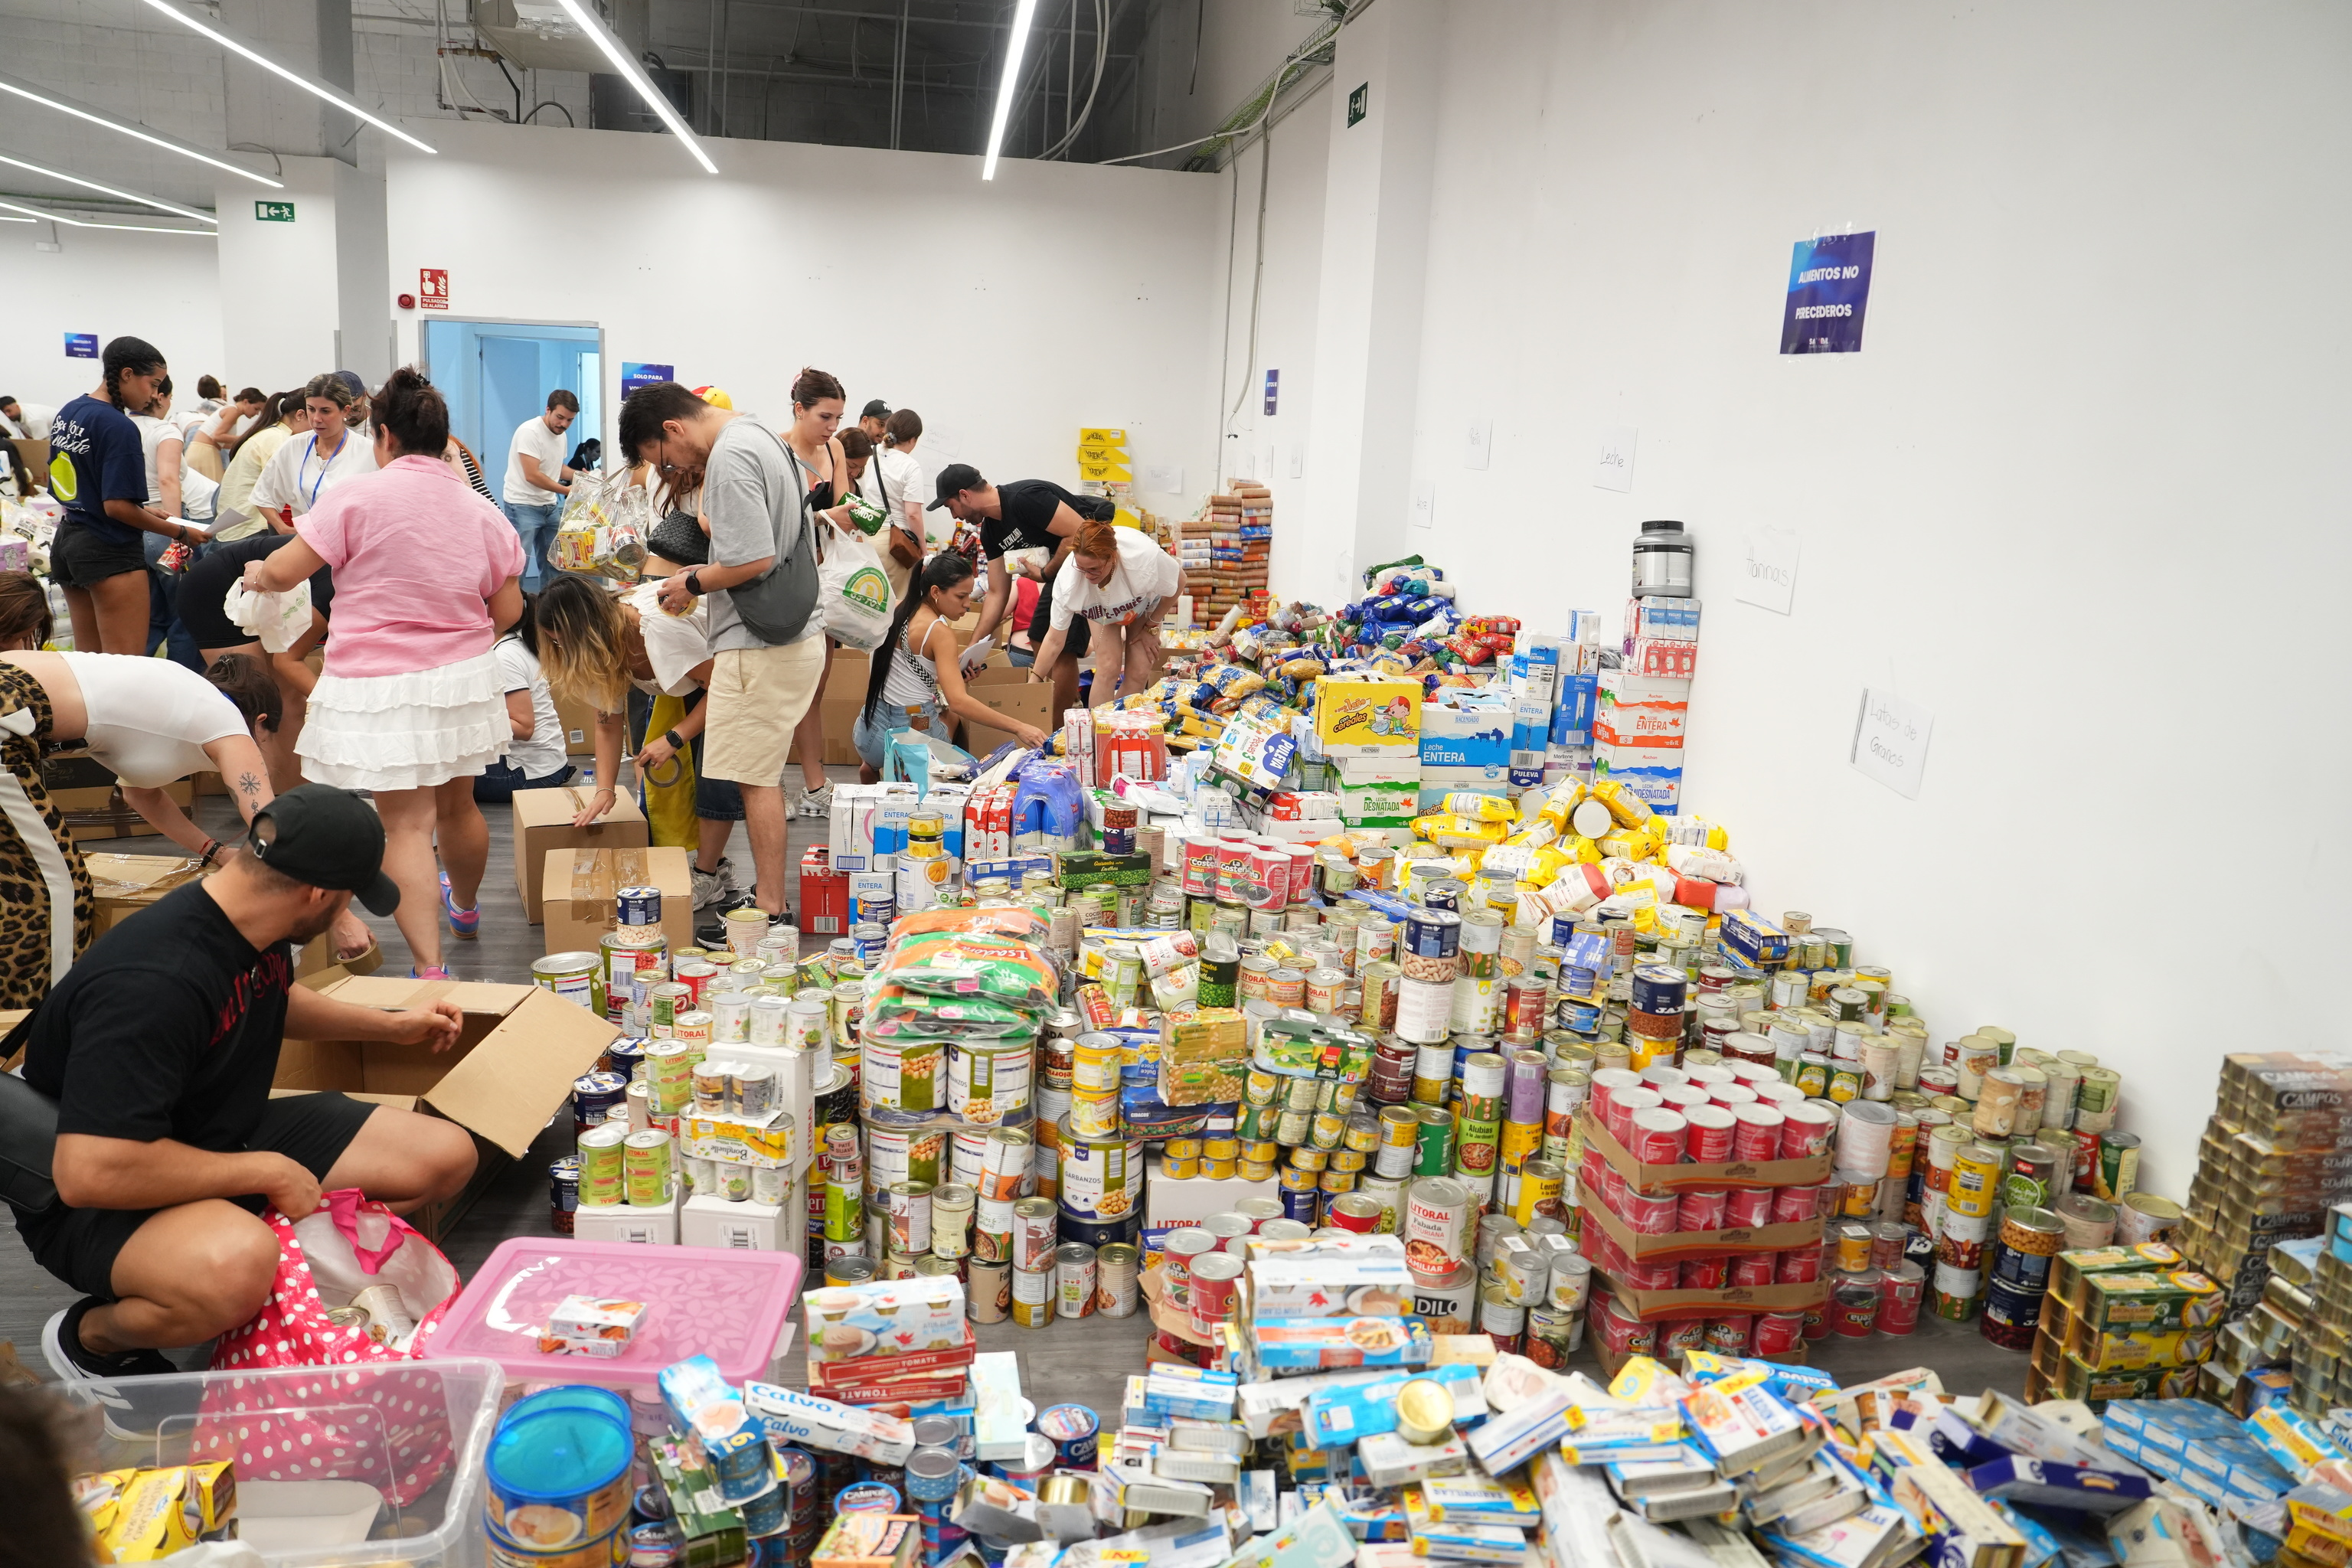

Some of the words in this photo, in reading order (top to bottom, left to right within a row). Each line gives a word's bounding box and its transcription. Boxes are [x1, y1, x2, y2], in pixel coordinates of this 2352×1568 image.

[1842, 265, 1860, 279] NO
[1468, 426, 1481, 446] Pasta
[1600, 446, 1625, 468] Leche
[1520, 707, 1543, 715] ENTERA
[1333, 713, 1367, 733] cereales
[1455, 715, 1479, 724] HACENDADO
[1637, 720, 1668, 730] ENTERA
[1870, 698, 1900, 732] Latas
[1904, 717, 1917, 741] de
[1246, 735, 1265, 755] Peques
[1870, 736, 1904, 768] Granos
[1242, 751, 1256, 762] 3
[1269, 739, 1295, 770] PULEVA
[1423, 752, 1465, 763] ENTERA
[1513, 769, 1539, 778] PULEVA
[1364, 802, 1400, 812] DESNATADA
[1488, 903, 1509, 912] Lentejas
[960, 945, 1028, 960] Isadora
[2281, 1092, 2341, 1108] CAMPOS
[1469, 1124, 1493, 1133] Alubias
[710, 1145, 748, 1160] Bonduelle
[1065, 1171, 1102, 1184] GARBANZOS
[1410, 1201, 1450, 1221] LITORAL
[1410, 1223, 1445, 1239] ASTURIANA
[1413, 1216, 1442, 1232] Fabada
[1173, 1263, 1181, 1272] La
[1406, 1256, 1443, 1272] FAMILIAR
[1410, 1322, 1425, 1337] 2
[901, 1356, 937, 1367] TOMATE
[1777, 1370, 1833, 1389] Calvo
[752, 1385, 832, 1413] Calvo
[839, 1388, 888, 1400] TOMATE
[761, 1416, 810, 1439] Calvo
